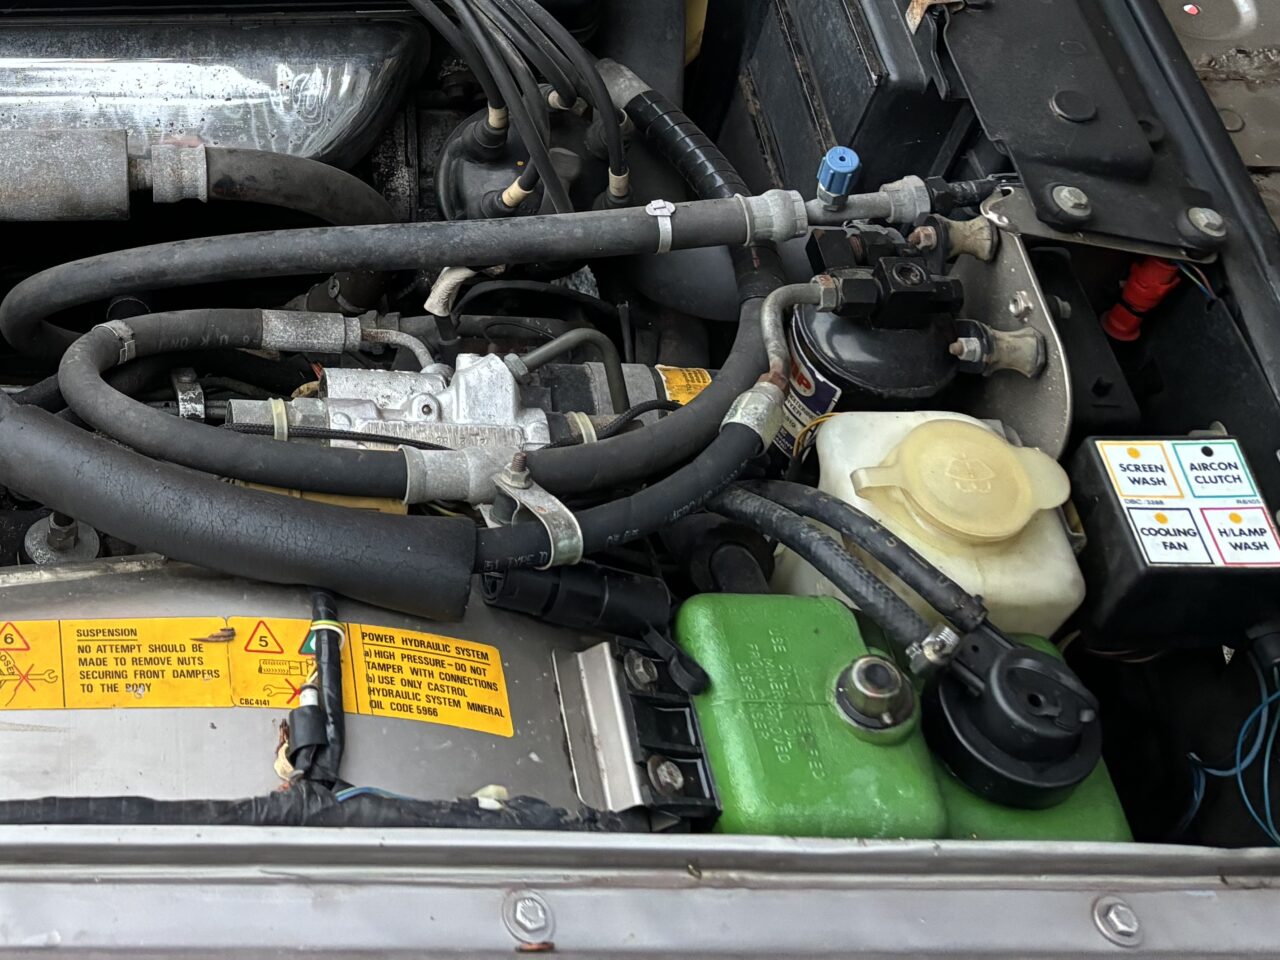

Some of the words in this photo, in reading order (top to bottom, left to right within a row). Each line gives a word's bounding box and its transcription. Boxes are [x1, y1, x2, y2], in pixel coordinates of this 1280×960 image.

[1119, 464, 1165, 473] SCREEN
[1189, 462, 1239, 471] AIRCON
[1127, 476, 1167, 486] WASH
[1195, 475, 1243, 484] CLUTCH
[1141, 527, 1198, 537] COOLING
[1218, 528, 1267, 537] H/LAMP
[1162, 541, 1188, 551] FAN
[1229, 541, 1270, 551] WASH
[76, 628, 138, 638] SUSPENSION
[4, 634, 14, 645] 6
[259, 635, 269, 647] 5
[77, 644, 92, 654] NO
[96, 644, 142, 654] ATTEMPT
[148, 644, 186, 653] SHOULD
[192, 643, 204, 653] BE
[362, 632, 396, 644] POWER
[401, 636, 451, 653] HYDRAULIC
[455, 645, 489, 661] SYSTEM
[78, 657, 108, 667] MADE
[114, 657, 126, 666] TO
[132, 656, 172, 666] REMOVE
[176, 656, 204, 666] NUTS
[374, 649, 395, 661] HIGH
[470, 665, 487, 677] NOT
[79, 670, 128, 680] SECURING
[134, 670, 167, 679] FRONT
[172, 669, 220, 679] DAMPERS
[366, 661, 404, 675] TAMPER
[409, 667, 435, 678] WITH
[439, 671, 499, 692] CONNECTIONS
[80, 683, 93, 692] TO
[100, 683, 119, 692] THE
[125, 682, 152, 693] BODY
[377, 674, 395, 685] USE
[400, 677, 423, 690] ONLY
[427, 681, 468, 698] CASTROL
[368, 686, 422, 702] HYDRAULIC
[425, 693, 461, 708] SYSTEM
[467, 700, 505, 718] MINERAL
[370, 700, 385, 711] OIL
[390, 702, 414, 714] CODE
[416, 704, 438, 717] 5966
